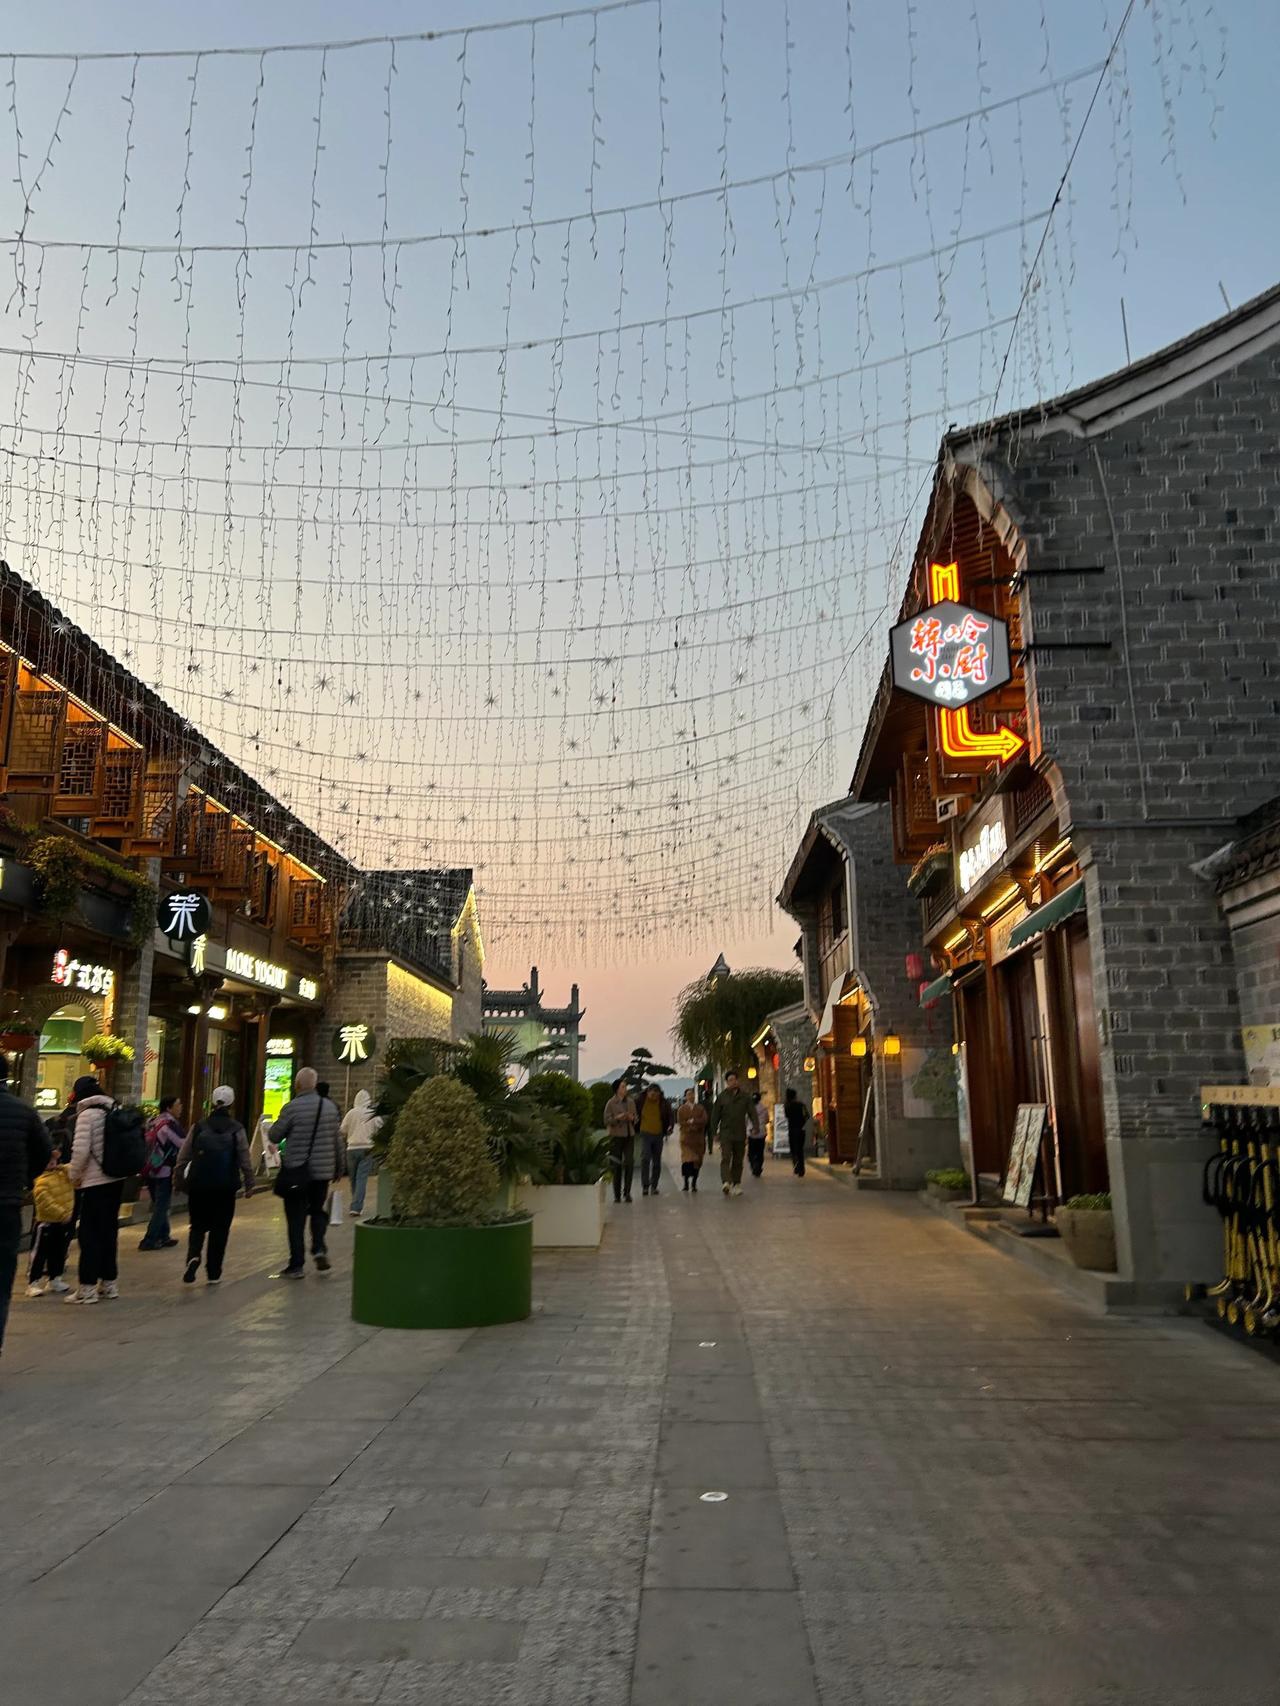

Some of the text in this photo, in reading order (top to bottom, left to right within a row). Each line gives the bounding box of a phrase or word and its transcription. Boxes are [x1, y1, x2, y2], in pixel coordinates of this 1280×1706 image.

[910, 643, 988, 685] 小厨
[225, 948, 254, 979] MORE
[254, 959, 288, 990] YOGURT
